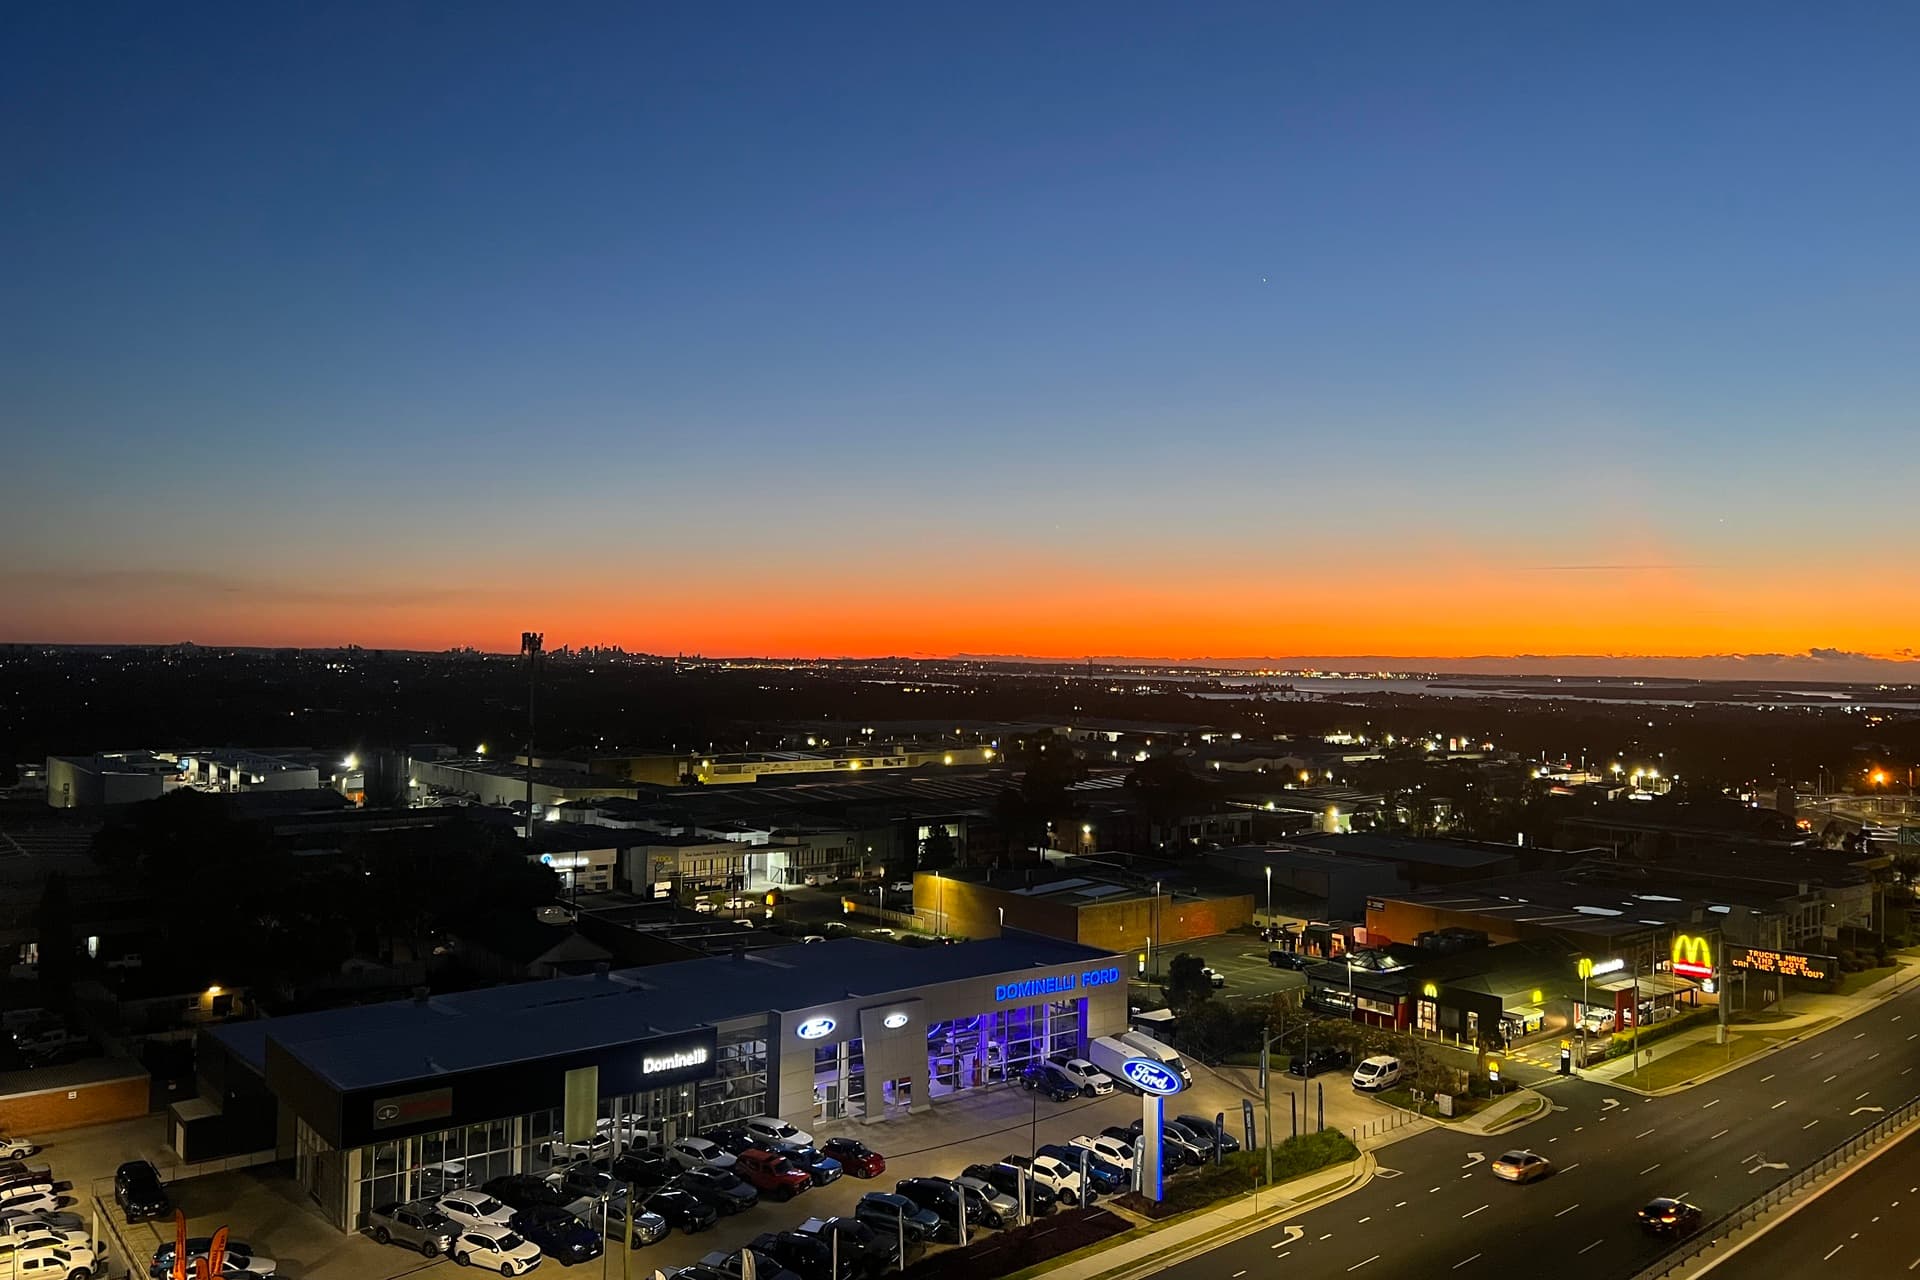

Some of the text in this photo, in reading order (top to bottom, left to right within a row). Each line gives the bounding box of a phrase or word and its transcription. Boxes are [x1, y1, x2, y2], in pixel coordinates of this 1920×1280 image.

[1746, 955, 1773, 965] BLIND
[1748, 949, 1808, 965] TRUCKS HAVE
[1732, 959, 1825, 980] CAN THEY SEE YOU?
[996, 966, 1120, 1002] DOMINELLI FORD
[643, 1047, 707, 1074] Dominelli
[1131, 1063, 1169, 1090] Ford
